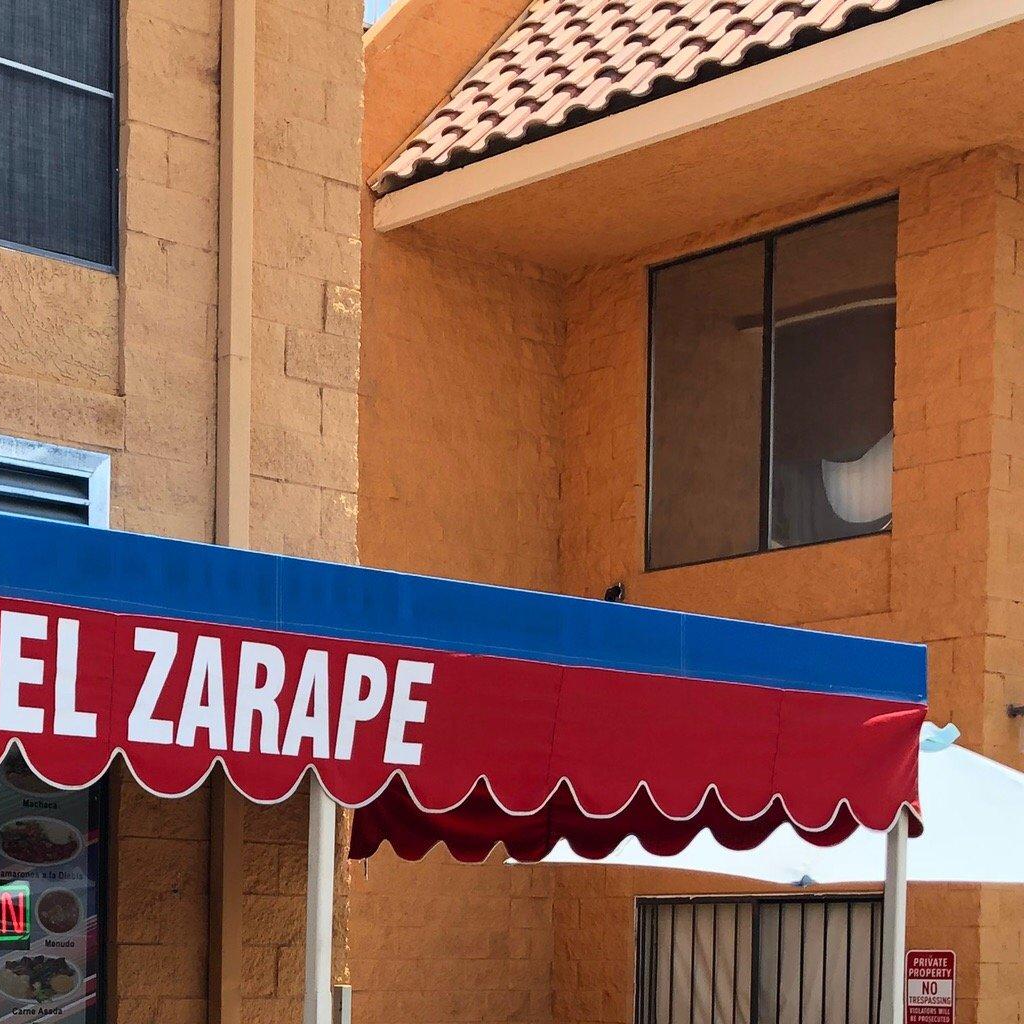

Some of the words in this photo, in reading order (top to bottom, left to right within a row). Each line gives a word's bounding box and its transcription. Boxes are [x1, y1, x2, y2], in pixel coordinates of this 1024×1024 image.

[127, 626, 435, 766] ZARAPE
[22, 799, 58, 809] Machaca
[45, 938, 75, 949] Menudo
[913, 957, 948, 967] PRIVATE
[908, 968, 952, 978] PROPERTY
[922, 981, 938, 995] NO
[909, 996, 951, 1005] TRESPASSING
[12, 1007, 36, 1016] Carne
[37, 1007, 63, 1016] Asada
[909, 1007, 937, 1015] VIOLATORS
[938, 1007, 950, 1015] WILL
[918, 1015, 950, 1023] PROSECUTED
